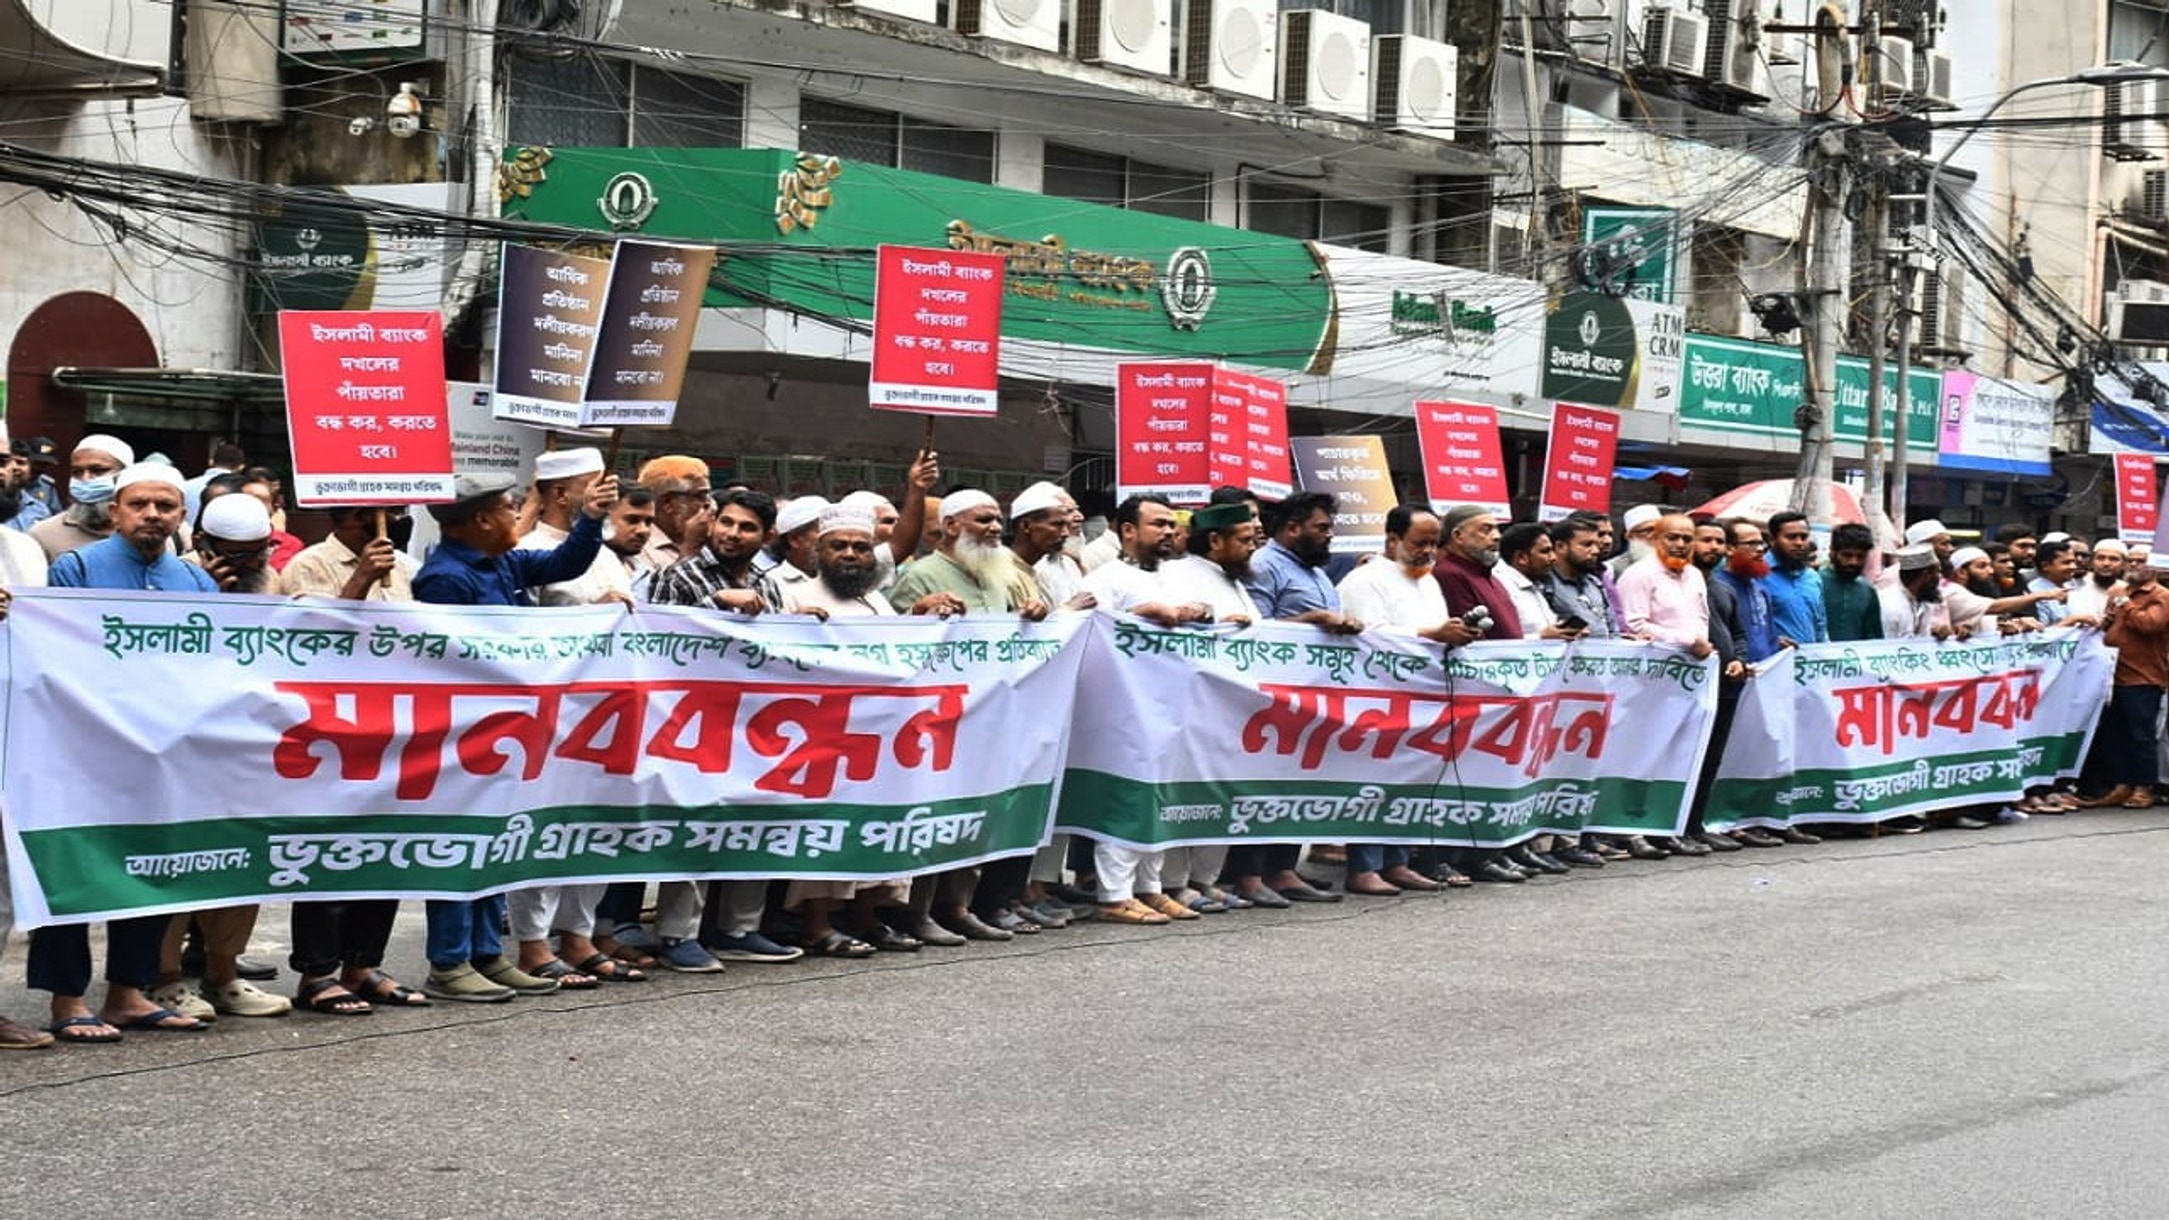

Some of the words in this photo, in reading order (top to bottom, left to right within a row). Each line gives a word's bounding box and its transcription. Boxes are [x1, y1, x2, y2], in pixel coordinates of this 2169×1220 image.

[311, 322, 374, 343] ইসলামী
[379, 328, 428, 343] ব্যাংক
[1650, 336, 1680, 358] CRM
[1652, 313, 1682, 335] ATM
[339, 356, 400, 371] দখলের
[1690, 351, 1729, 392] উত্তরা
[1732, 363, 1772, 398] ব্যাংক
[315, 415, 343, 430] বন্ধ
[387, 415, 437, 430] করতে
[102, 612, 213, 660] ইসলামী
[223, 626, 358, 666] ব্যাংকের
[369, 624, 449, 660] উপর
[1222, 637, 1297, 672] ব্যাংক
[1304, 643, 1359, 684] সমূহ
[1363, 648, 1431, 682] থেকে
[1646, 654, 1708, 692] দাবিতে
[272, 679, 969, 800] মানববন্ধন
[1833, 759, 1930, 811] ভুক্তভোগী
[1932, 761, 1995, 789] গ্রাহক
[1228, 785, 1387, 835] ভুক্তভোগী
[1383, 796, 1488, 827] গ্রাহক
[268, 813, 534, 887] ভুক্তভোগী
[533, 820, 680, 861] গ্রাহক
[684, 818, 850, 859] সমন্বয়
[860, 806, 988, 855] পরিষদ
